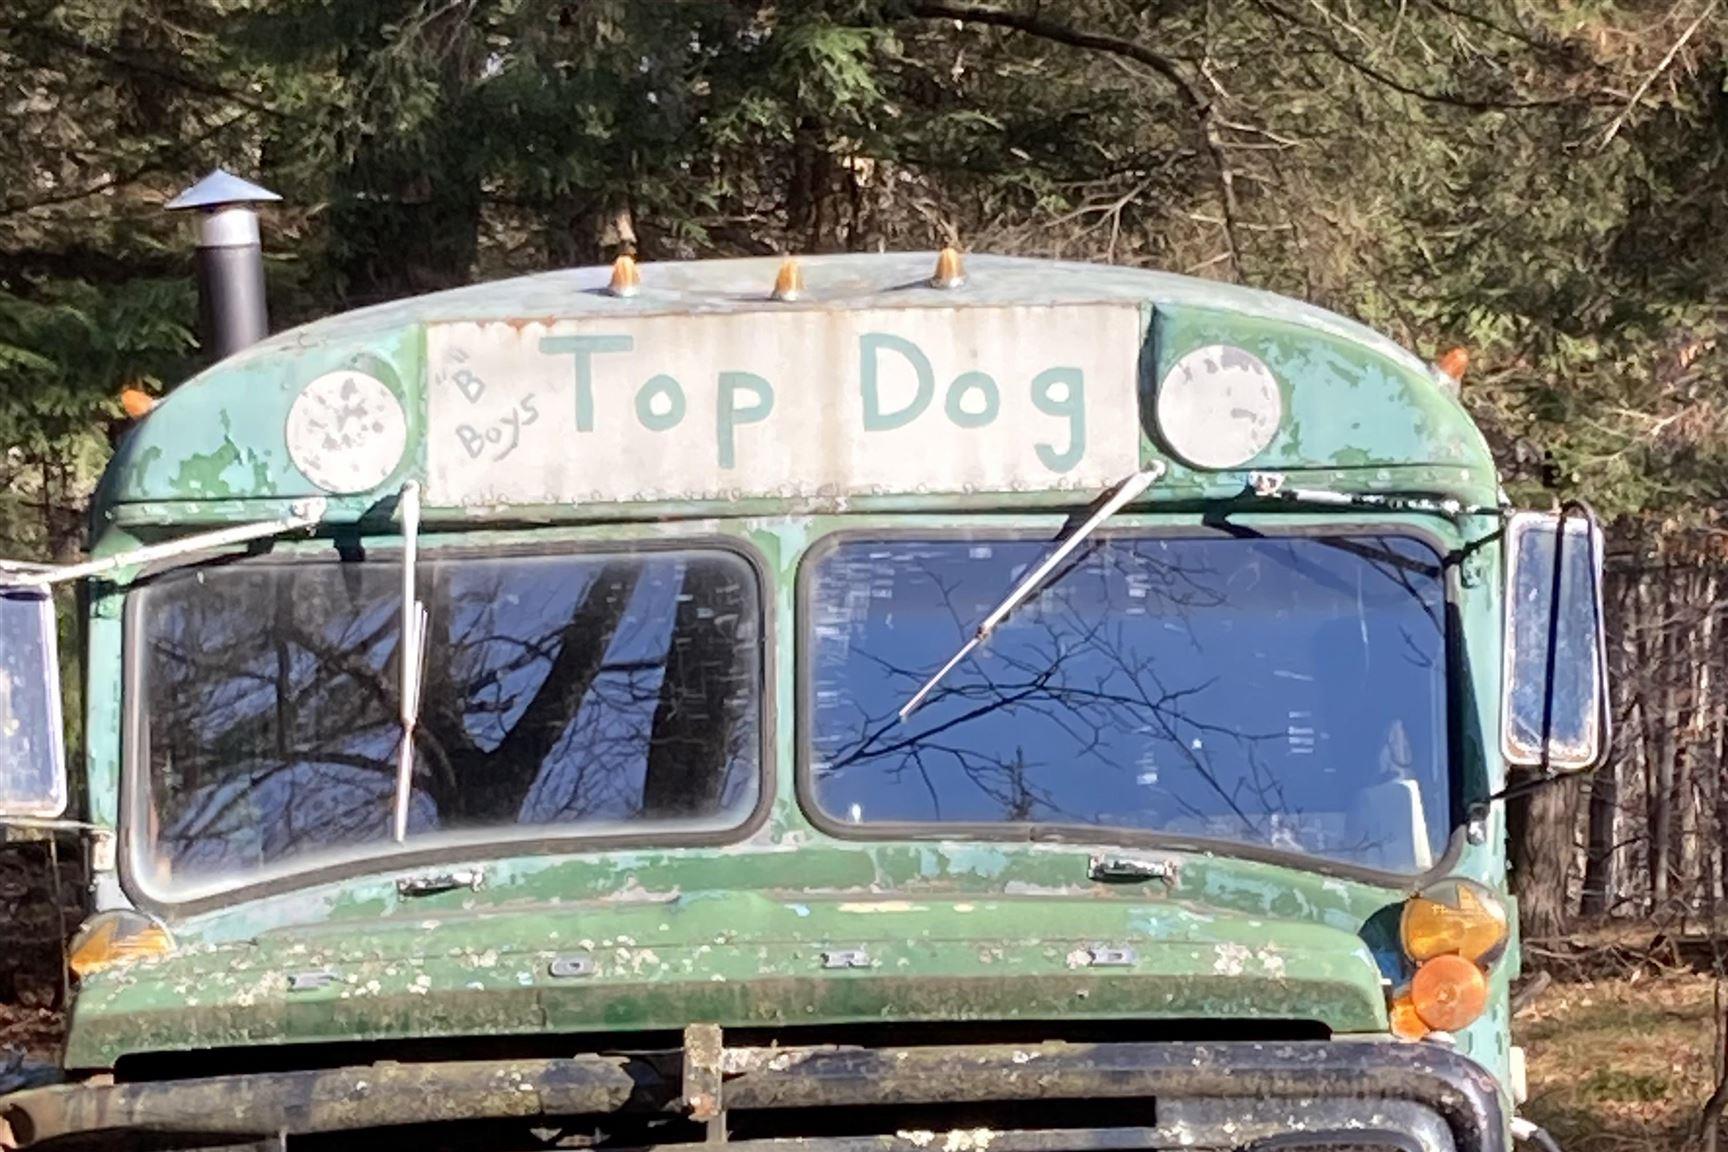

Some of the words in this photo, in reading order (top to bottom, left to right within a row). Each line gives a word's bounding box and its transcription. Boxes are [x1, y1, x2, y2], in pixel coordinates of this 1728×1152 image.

[455, 393, 539, 462] Boys
[539, 334, 774, 469] Top
[859, 332, 1085, 473] Dog
